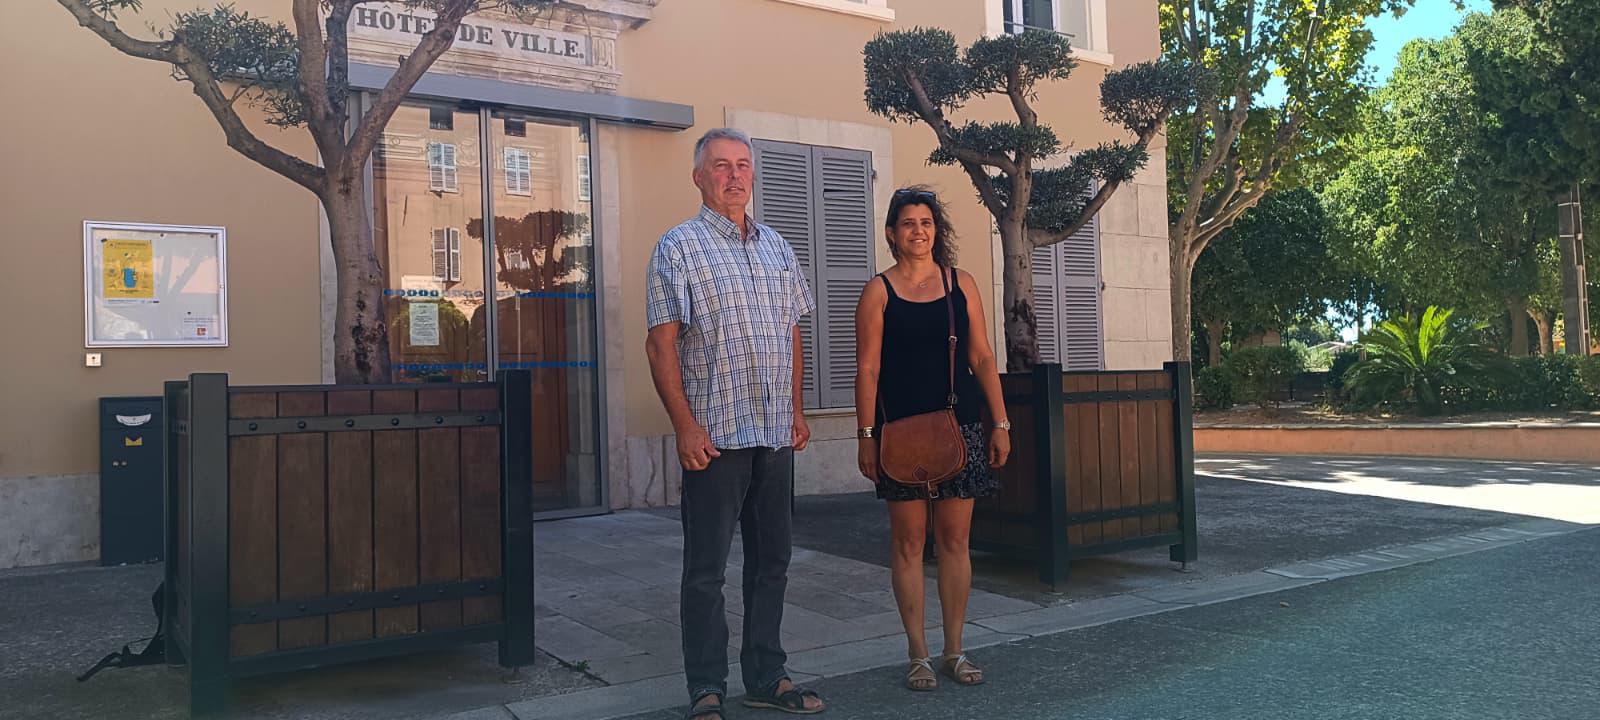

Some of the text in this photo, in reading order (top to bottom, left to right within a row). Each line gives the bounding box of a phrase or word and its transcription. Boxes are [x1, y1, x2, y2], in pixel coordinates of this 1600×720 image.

[356, 5, 584, 58] HÔTE DE VILLE.
